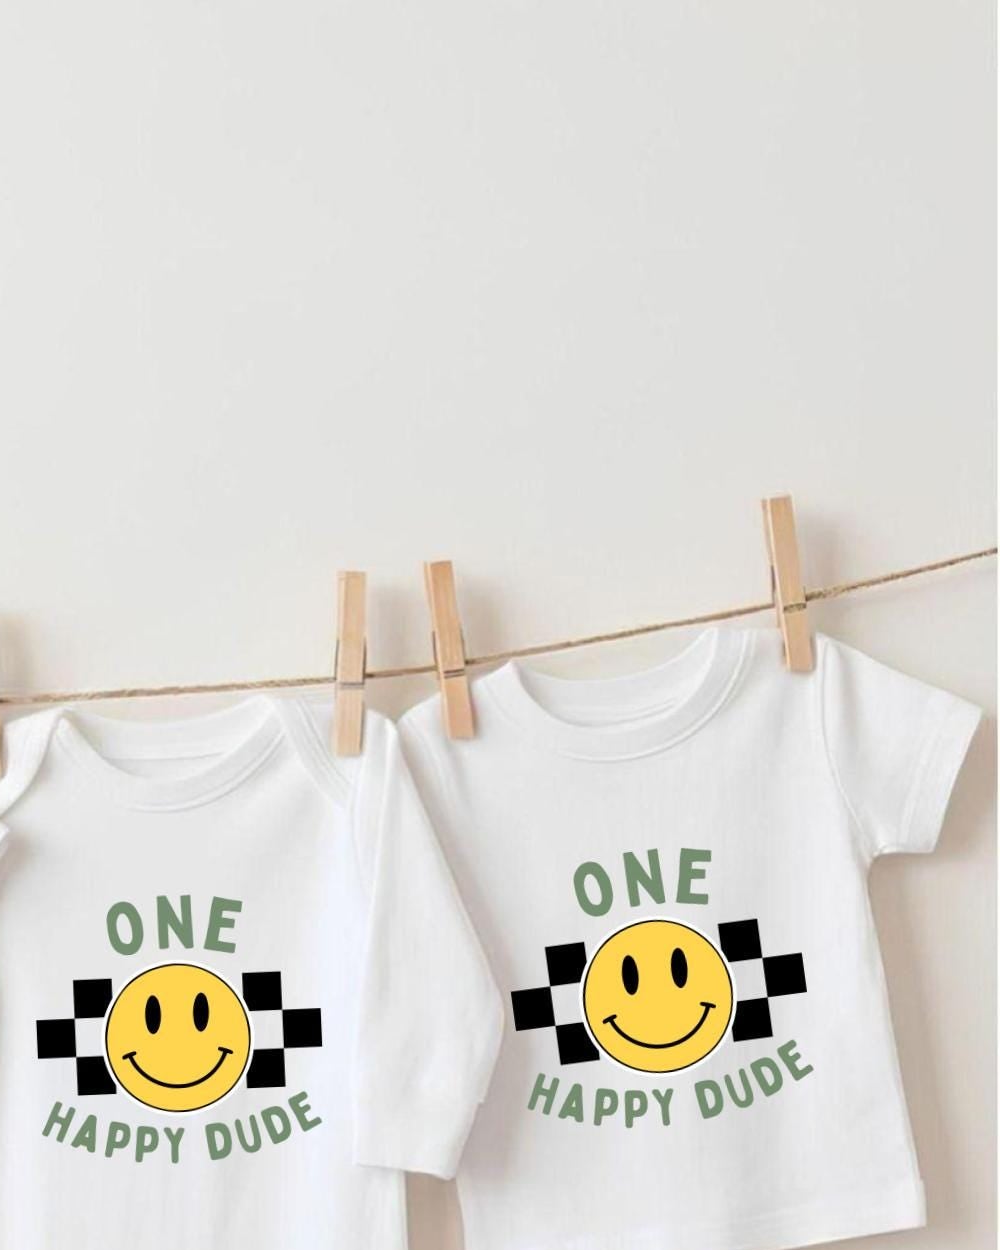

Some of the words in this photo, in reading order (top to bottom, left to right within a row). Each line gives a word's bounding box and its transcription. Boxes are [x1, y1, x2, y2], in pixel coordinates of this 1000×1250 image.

[572, 847, 713, 917] ONE
[105, 895, 243, 956] ONE
[527, 1072, 675, 1129] HAPPY
[695, 1040, 812, 1120] DUDE
[41, 1102, 185, 1164] HAPPY
[204, 1091, 323, 1162] DUDE
